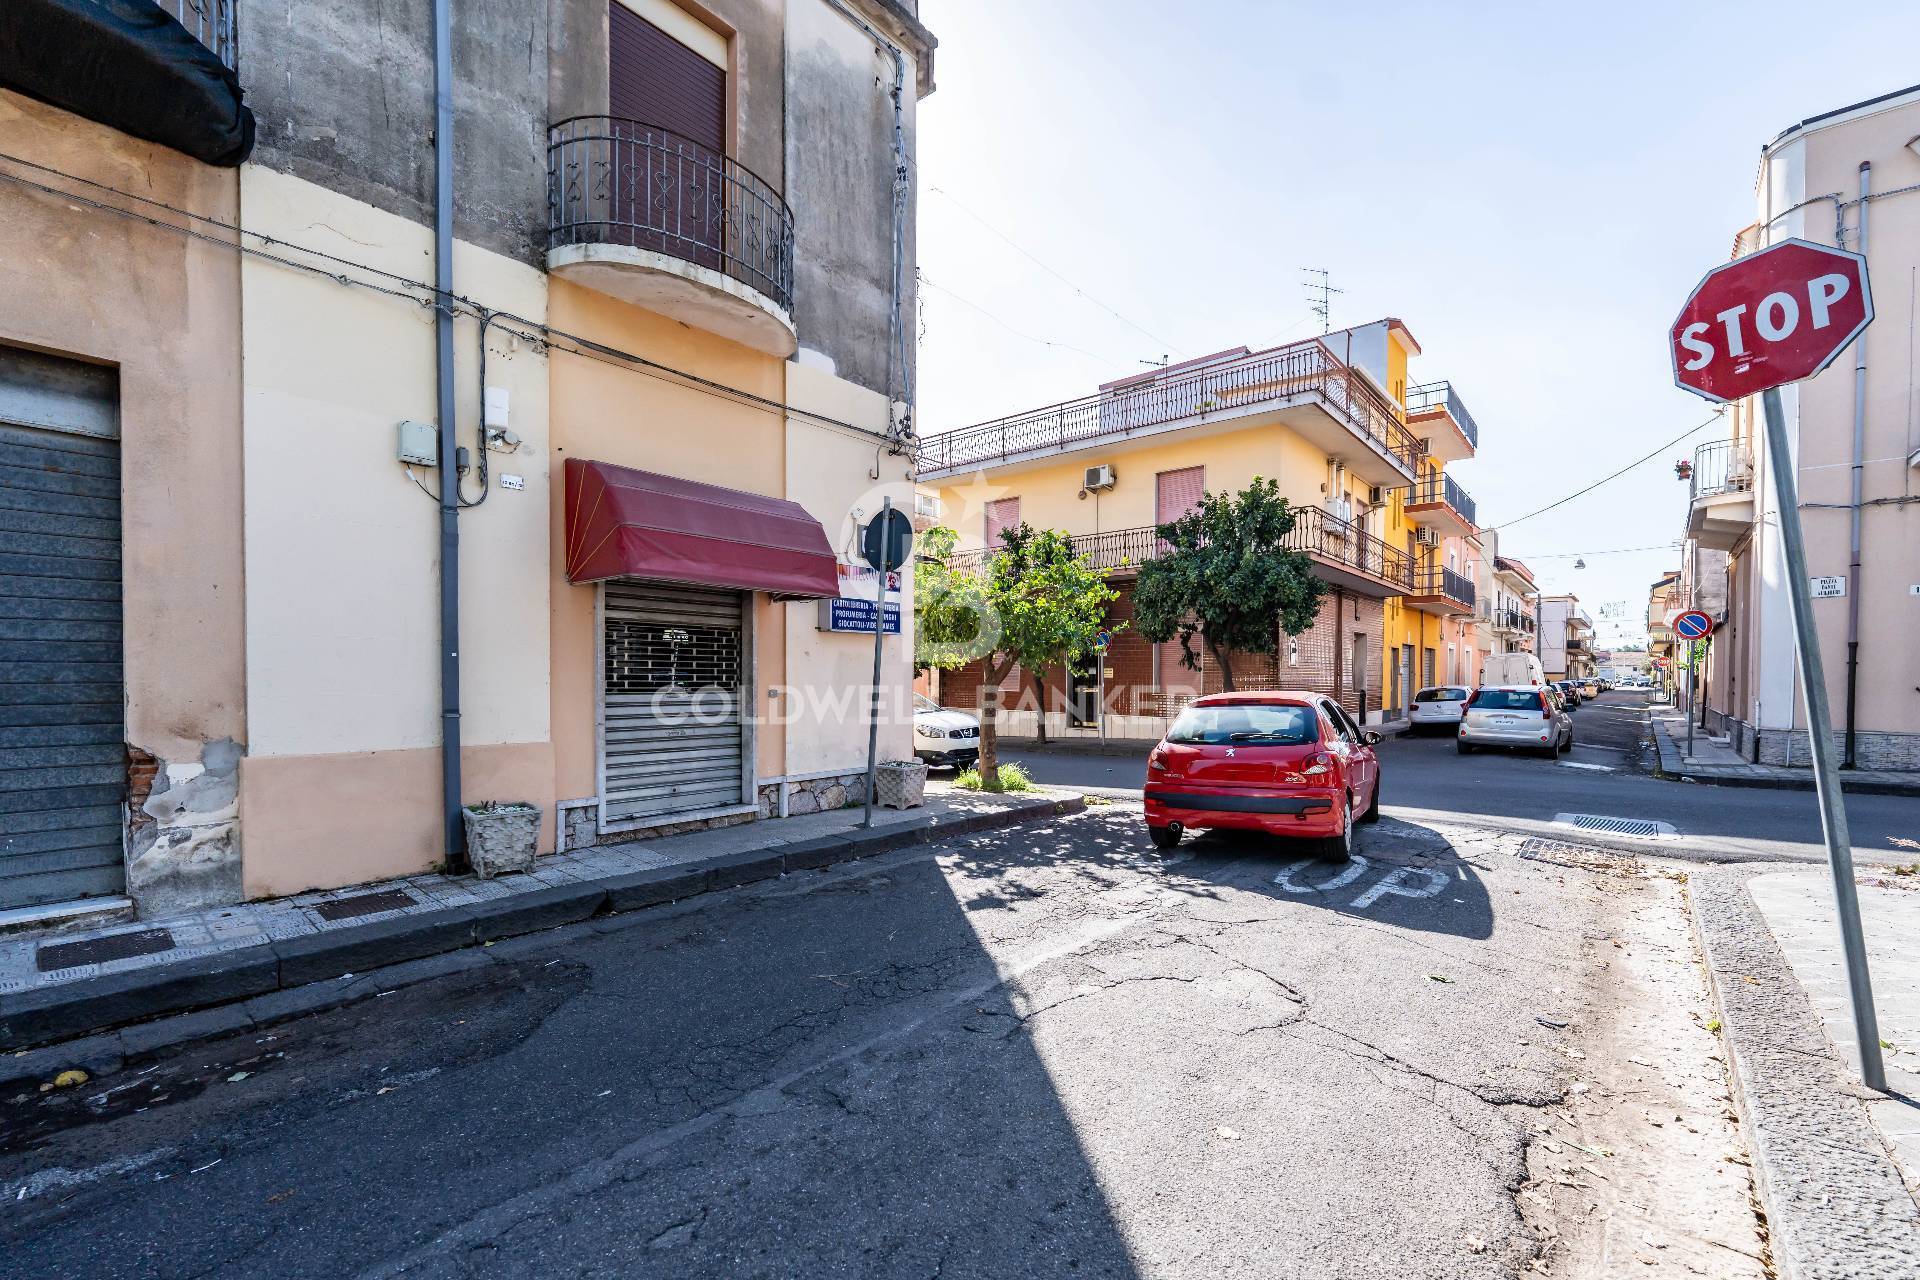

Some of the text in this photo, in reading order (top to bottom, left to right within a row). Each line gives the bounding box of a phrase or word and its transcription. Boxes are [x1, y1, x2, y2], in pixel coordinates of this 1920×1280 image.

[1680, 273, 1850, 371] STOP
[833, 599, 869, 610] CARTOLIBRERIA
[872, 602, 899, 612] PETTERIA
[835, 609, 867, 619] PROFUMERIA
